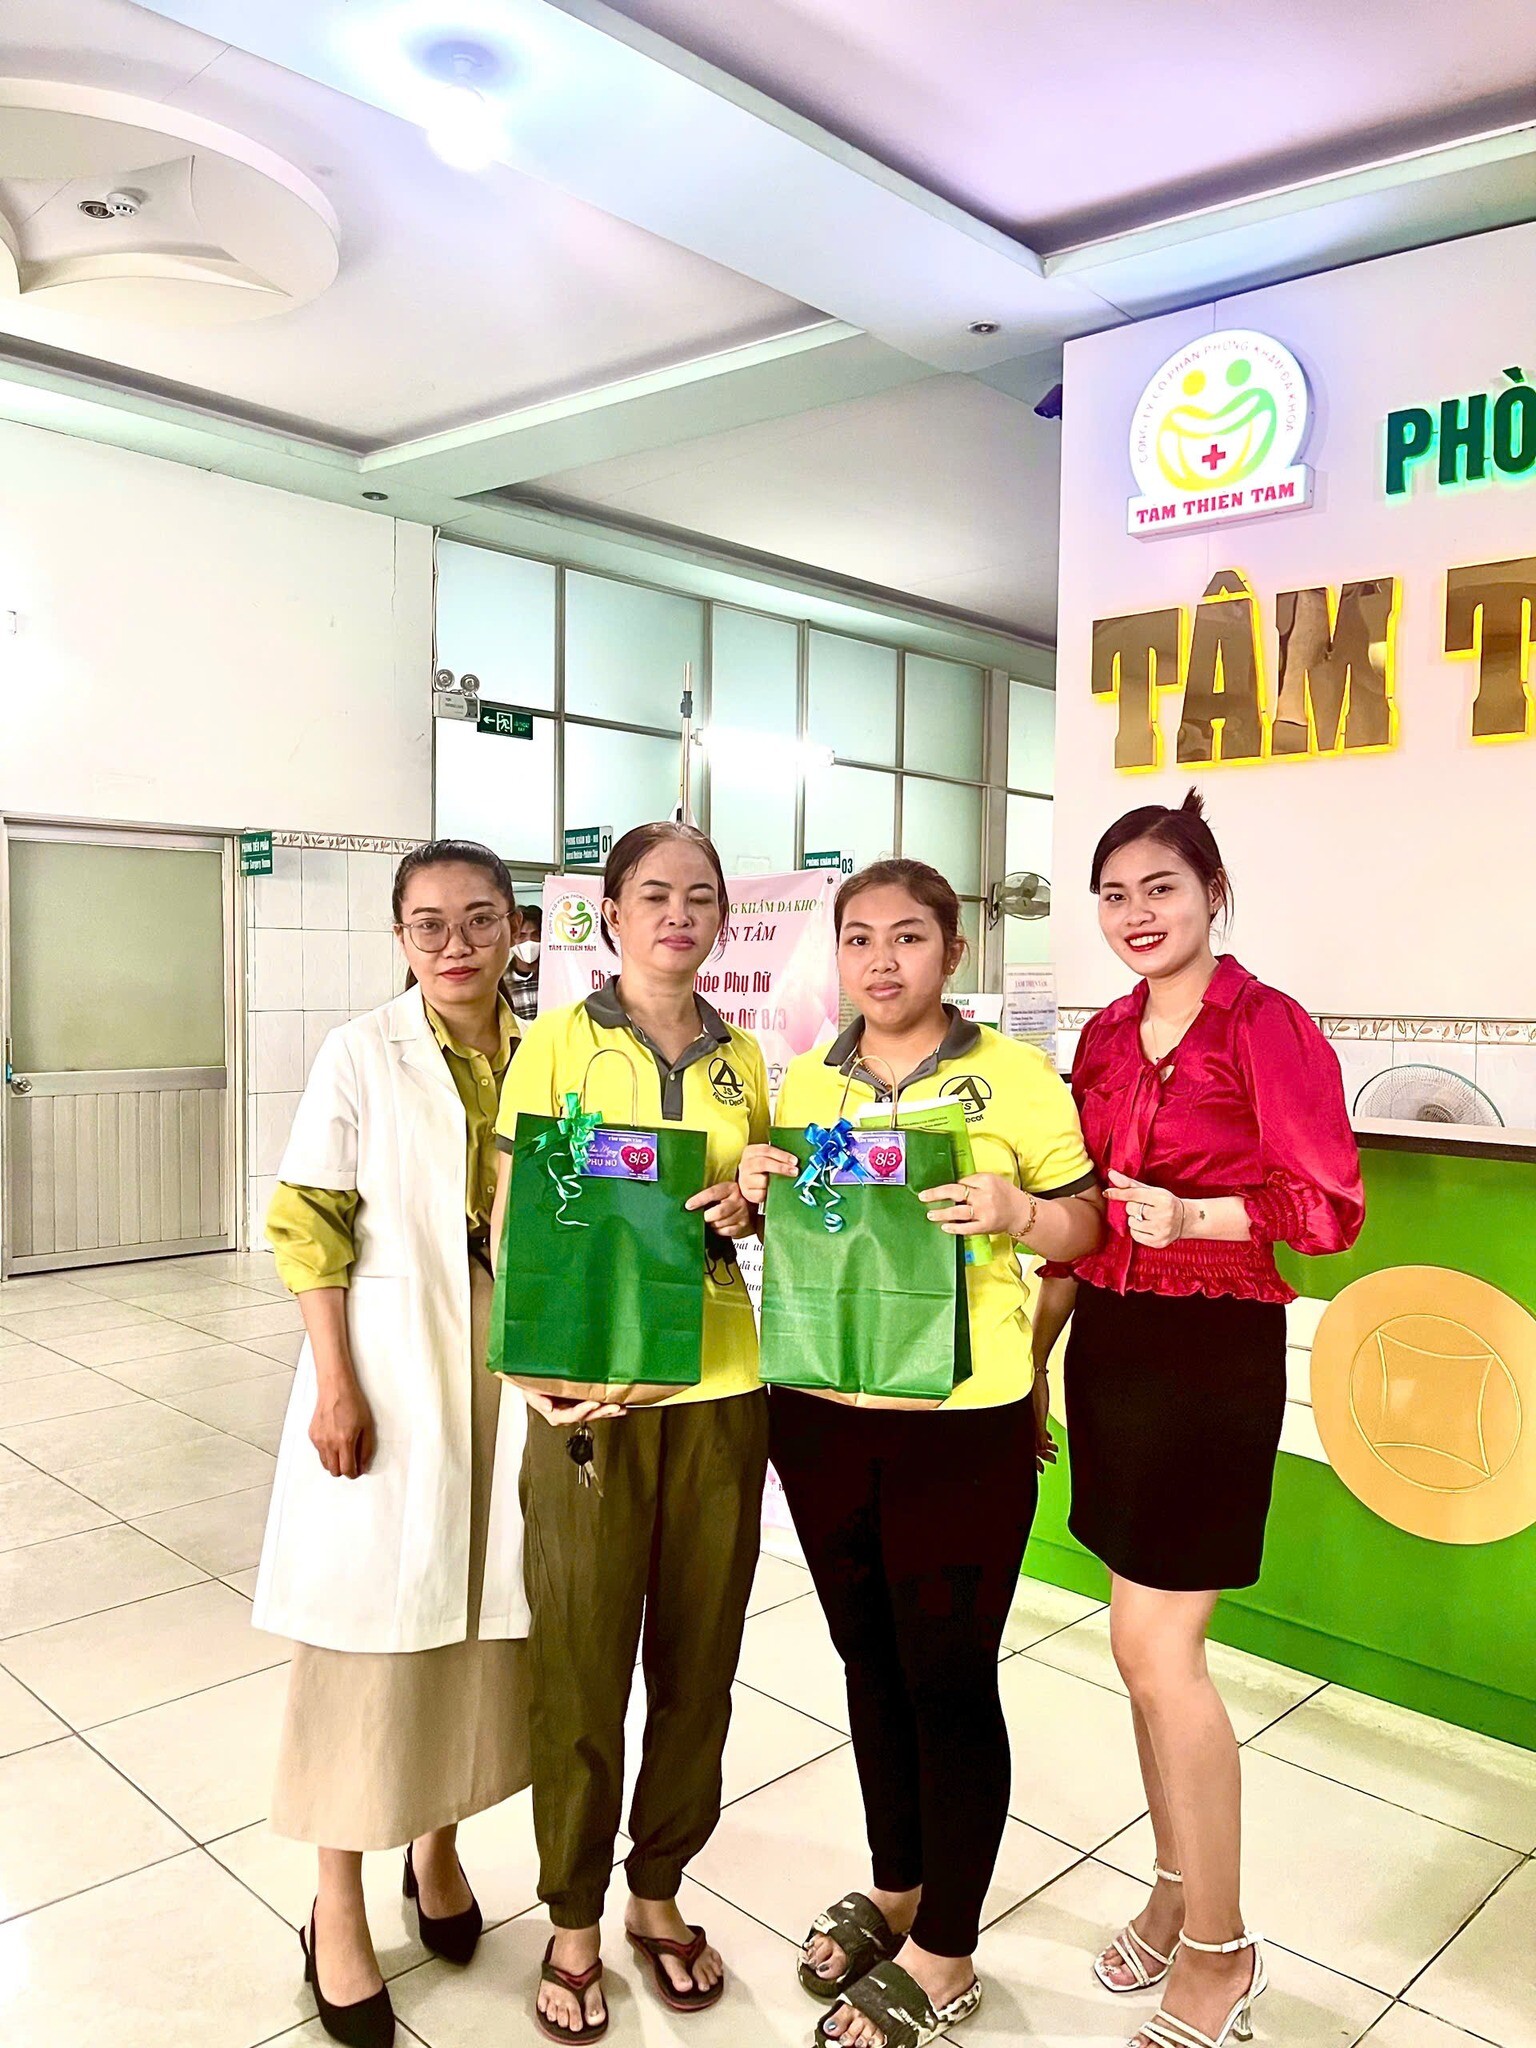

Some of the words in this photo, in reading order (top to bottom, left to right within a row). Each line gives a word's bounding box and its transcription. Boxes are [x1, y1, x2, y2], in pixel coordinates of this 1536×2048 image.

[1091, 569, 1397, 772] TÂM
[1444, 557, 1536, 741] T
[602, 835, 612, 853] 01
[842, 858, 853, 873] 03
[741, 899, 774, 914] KHÁM
[777, 901, 792, 912] ĐA
[743, 921, 777, 942] TÂM
[694, 971, 719, 993] hỏe
[724, 971, 749, 996] Phụ
[753, 970, 772, 993] Nữ
[761, 1008, 787, 1031] 8/3
[960, 1007, 975, 1019] ÂM
[965, 1114, 984, 1123] ecor
[629, 1152, 649, 1165] 8/3
[875, 1152, 897, 1167] 8/3
